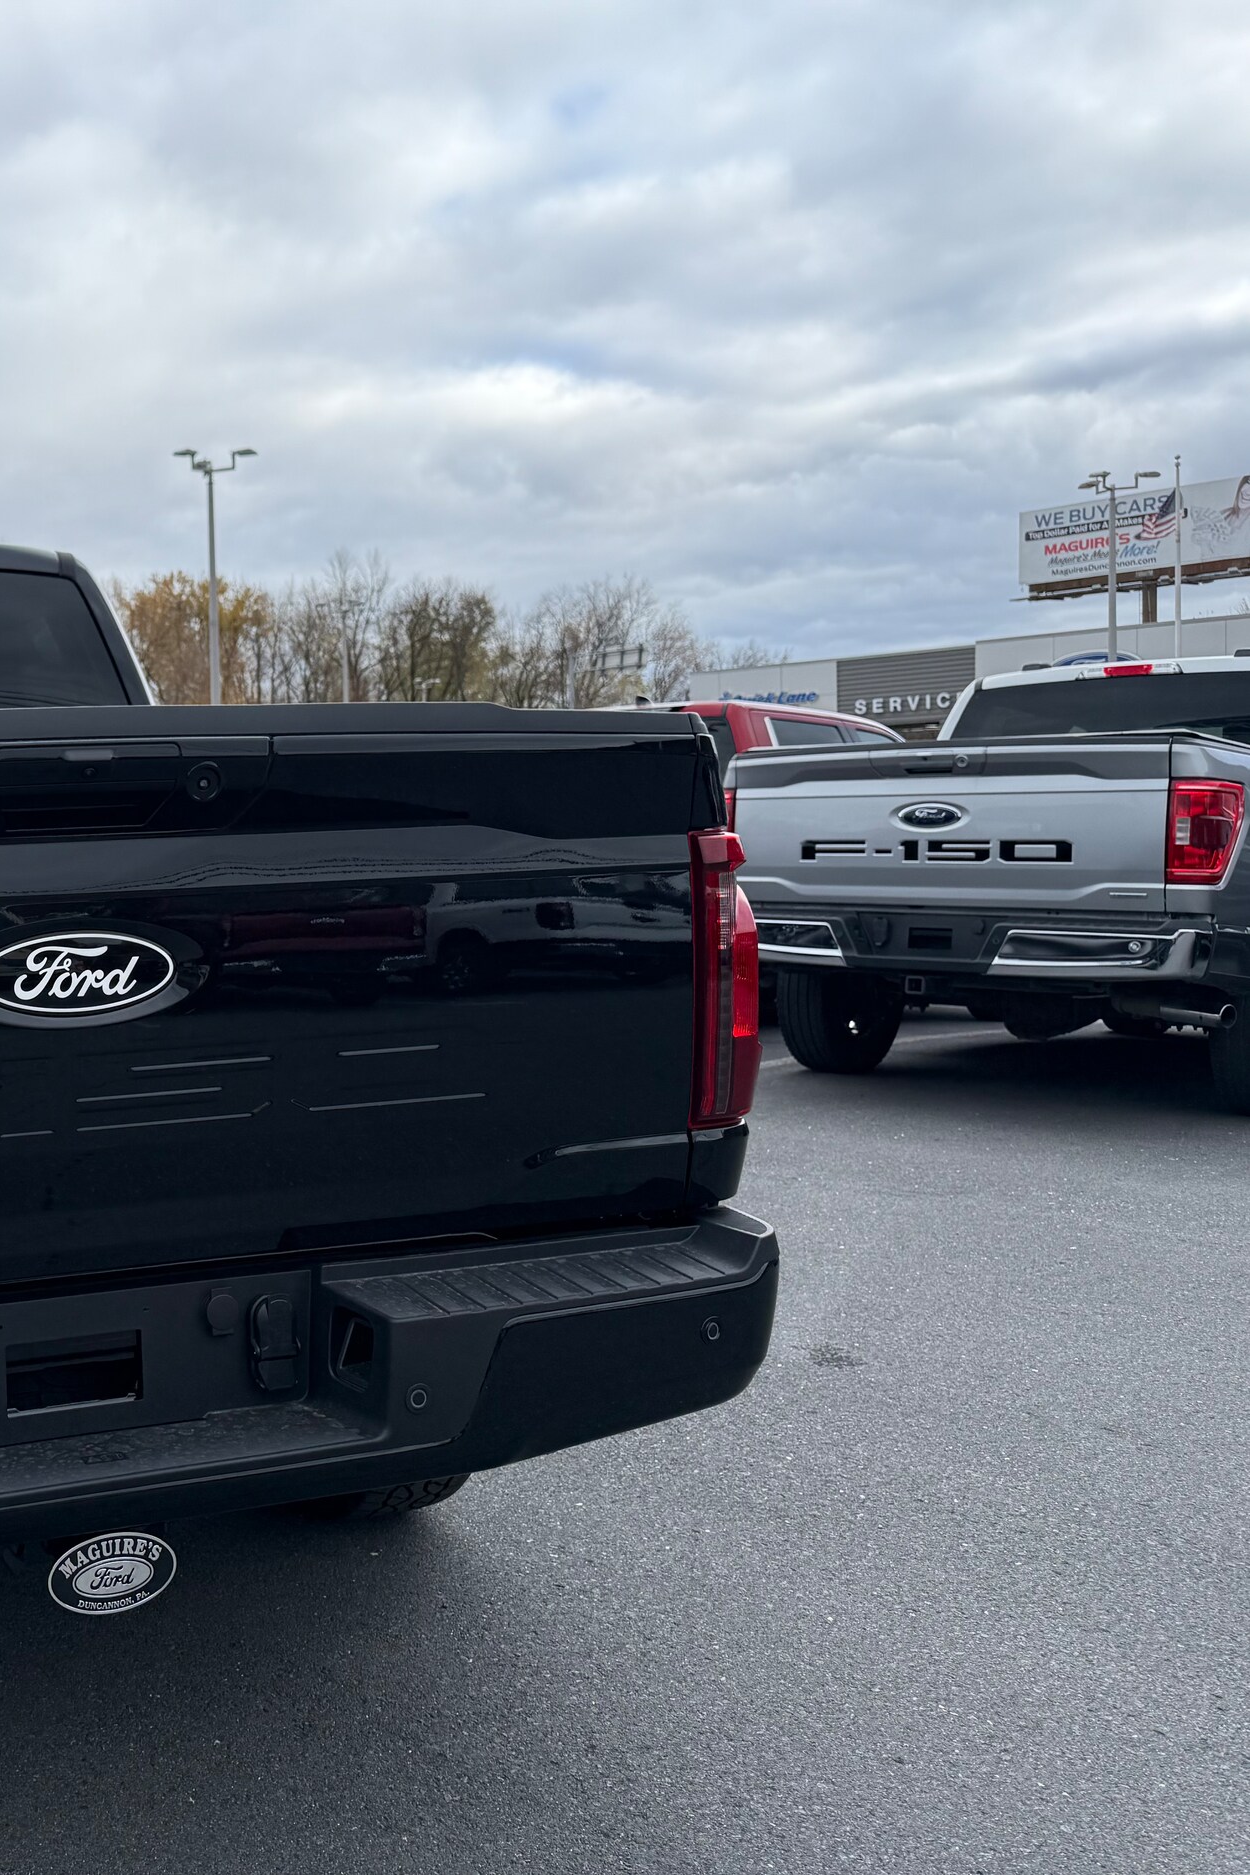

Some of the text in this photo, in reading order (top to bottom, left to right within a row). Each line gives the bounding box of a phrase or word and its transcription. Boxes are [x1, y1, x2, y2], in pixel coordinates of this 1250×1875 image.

[1029, 530, 1043, 540] Top
[1044, 527, 1068, 538] Dollar
[1069, 524, 1088, 535] Paid
[1089, 521, 1101, 531] for
[1115, 515, 1143, 527] Makes
[1035, 511, 1064, 528] WE
[1069, 504, 1109, 523] BUY
[1119, 540, 1161, 559] More!
[1051, 557, 1157, 576] MaguiresDuncnnon.com
[777, 691, 818, 704] Lane
[854, 691, 963, 715] SERVIC
[799, 839, 1074, 865] F-150
[14, 945, 139, 1001] Ford
[58, 1538, 162, 1579] MAGUIRE'S
[90, 1565, 135, 1591] Ford
[78, 1590, 150, 1610] DUNCANNON, PA.
